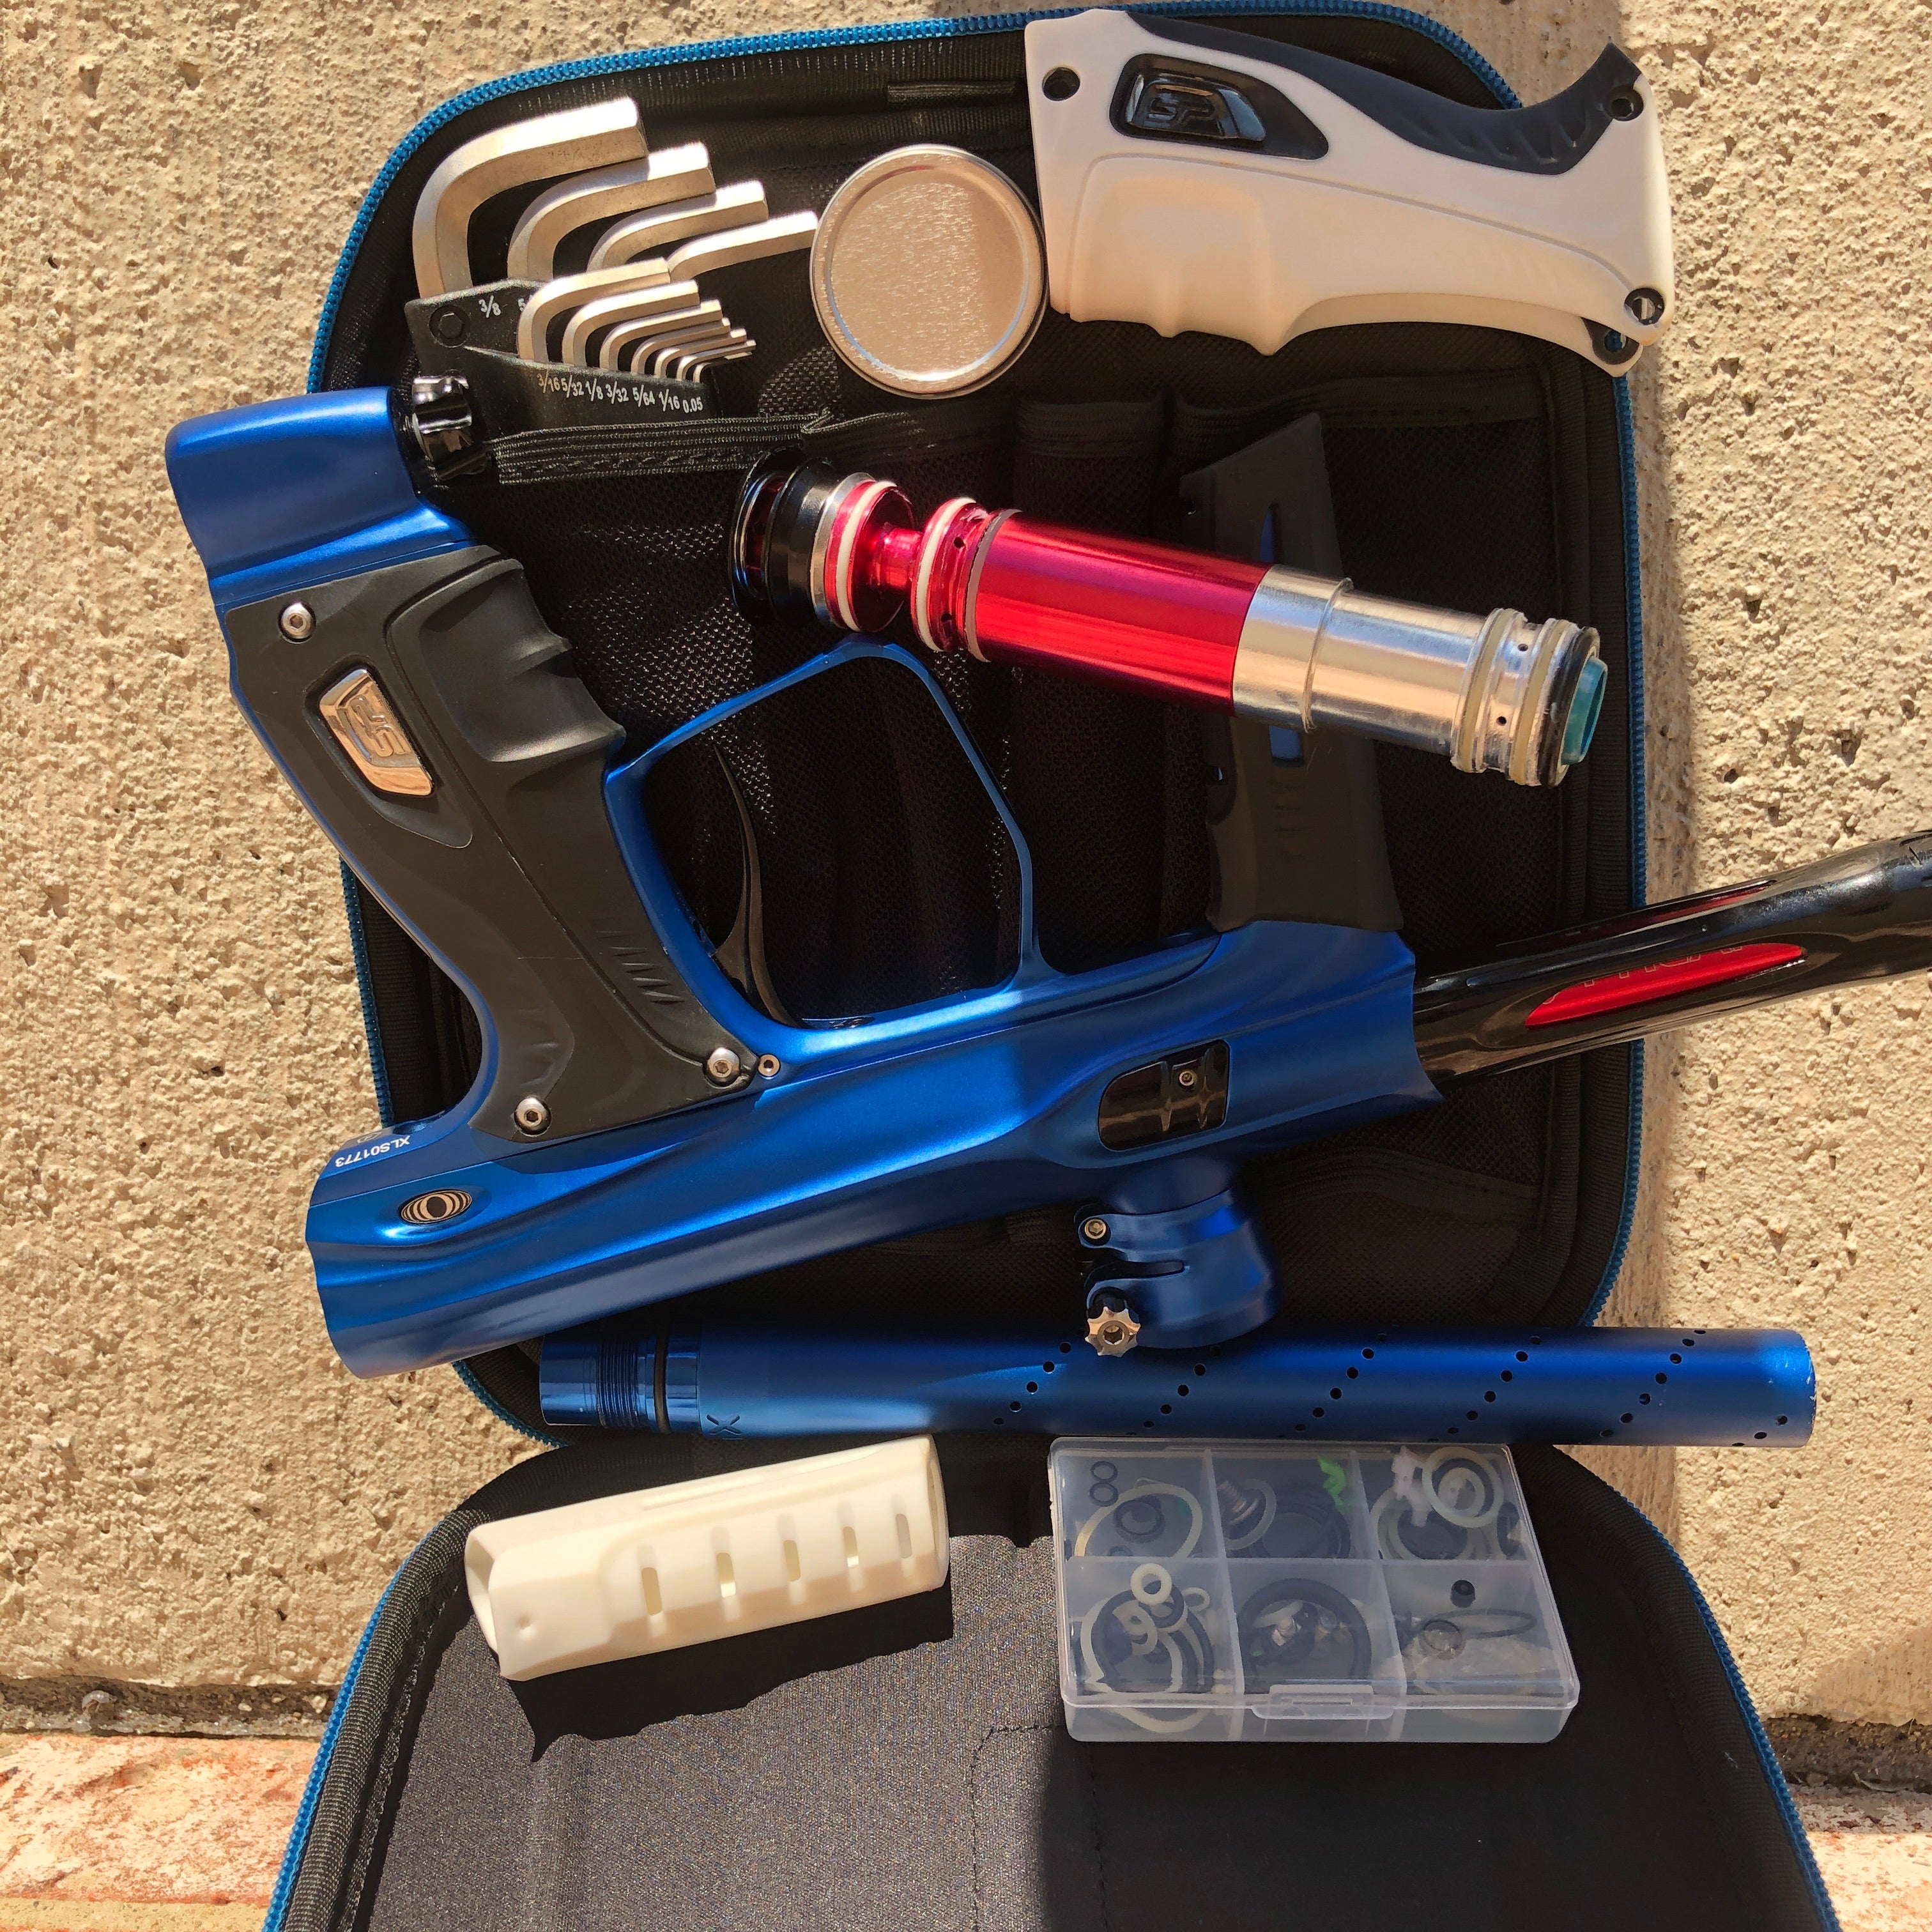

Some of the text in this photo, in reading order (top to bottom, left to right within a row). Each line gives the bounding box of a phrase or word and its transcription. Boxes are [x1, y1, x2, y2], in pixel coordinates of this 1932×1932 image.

[478, 295, 502, 318] 3/8
[537, 369, 703, 413] 3/16 5/32 1/8 3/32 5/64 1/16 0.05
[335, 1135, 411, 1168] XLS01773
